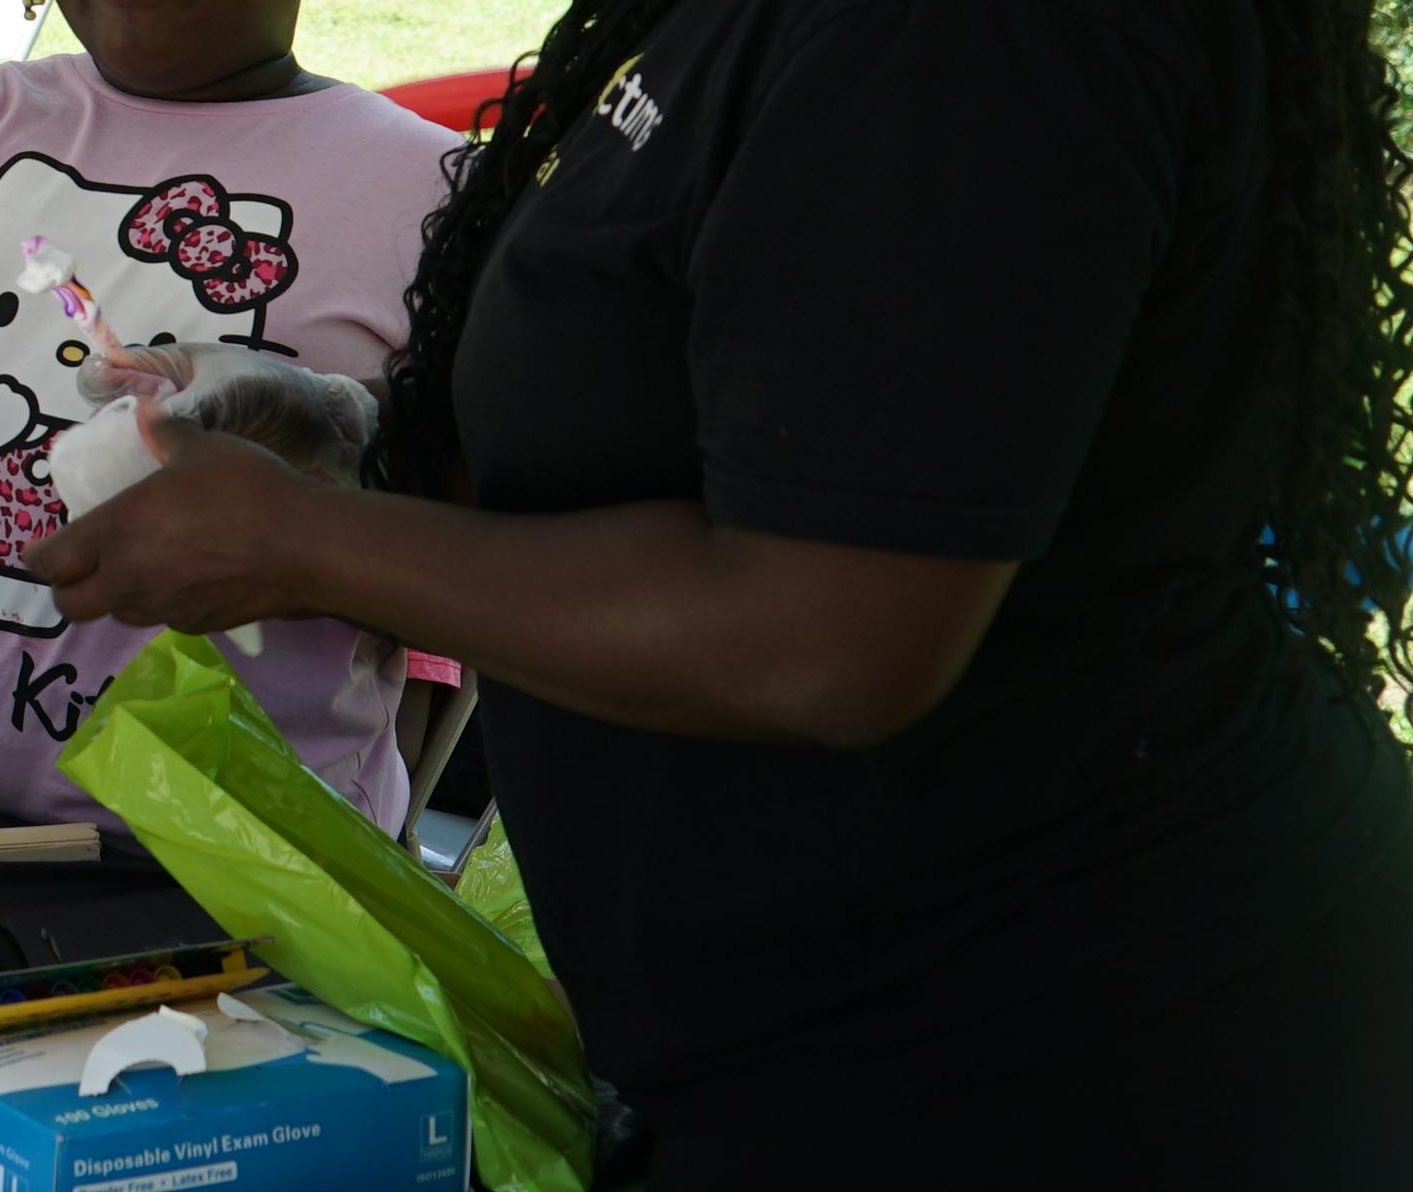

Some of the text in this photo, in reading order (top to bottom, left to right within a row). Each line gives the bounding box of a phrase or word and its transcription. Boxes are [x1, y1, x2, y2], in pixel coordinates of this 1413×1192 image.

[91, 1098, 160, 1119] Gloves
[428, 1115, 448, 1145] L
[74, 1123, 322, 1178] Disposable Vinyl Exam Glove
[172, 1171, 204, 1187] Latex
[207, 1166, 233, 1182] Free
